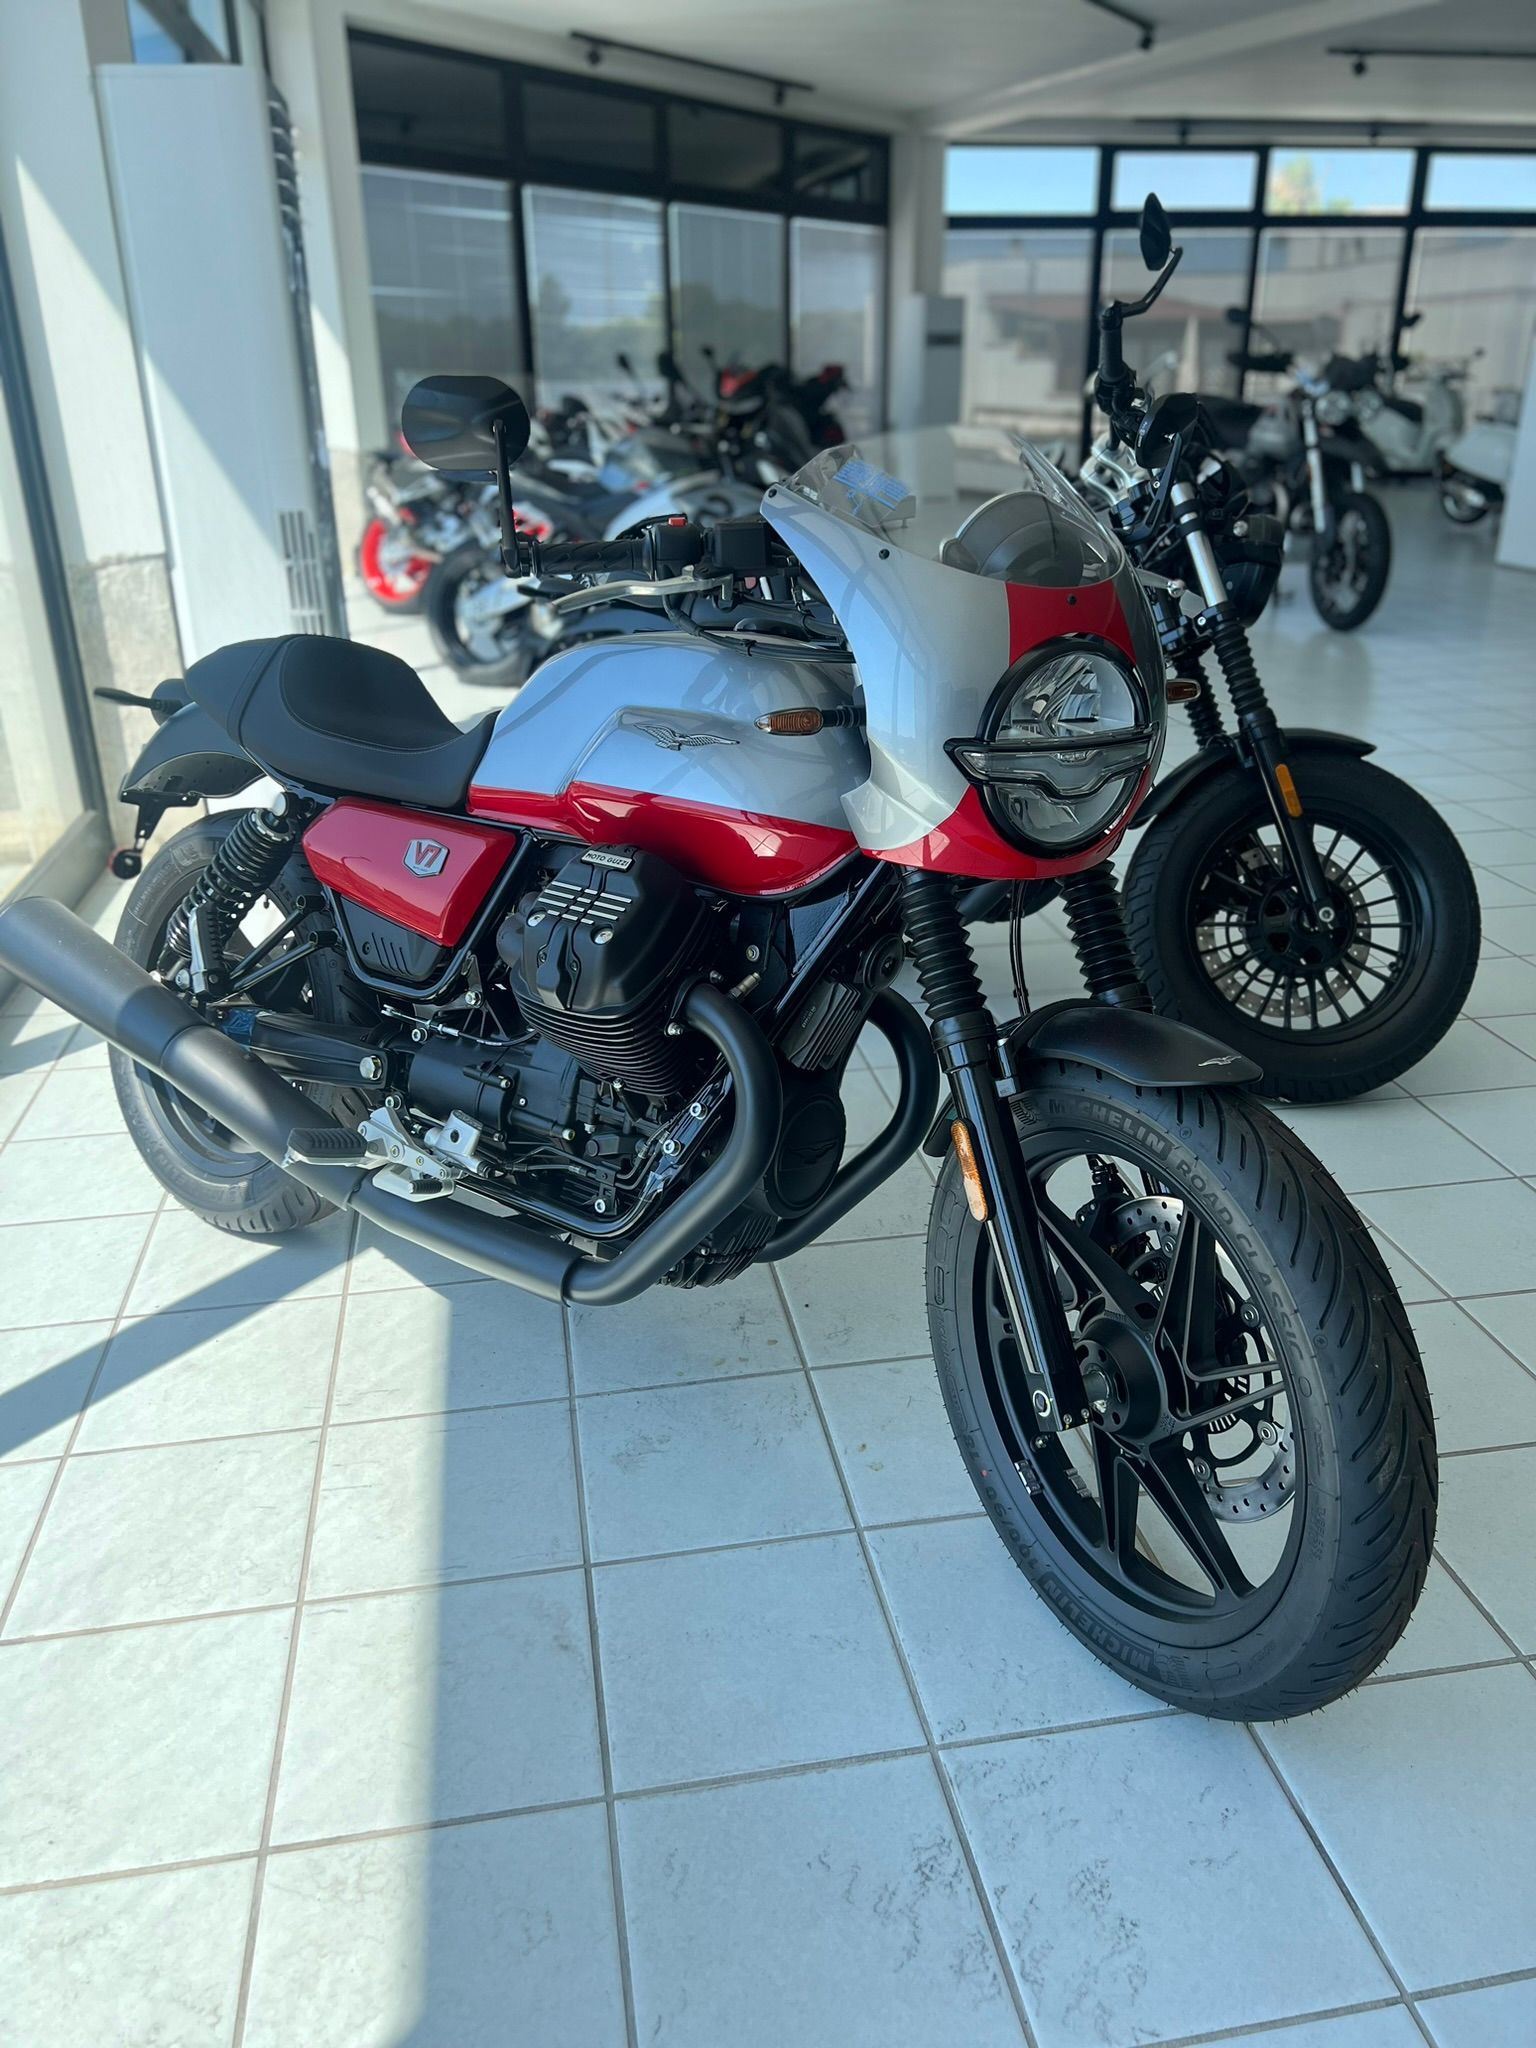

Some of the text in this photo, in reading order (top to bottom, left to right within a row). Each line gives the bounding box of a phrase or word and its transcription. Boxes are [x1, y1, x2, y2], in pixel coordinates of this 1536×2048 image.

[414, 840, 442, 868] V7
[586, 853, 629, 867] MOTO GUZZI
[1051, 1101, 1167, 1154] MICHELIN
[1176, 1160, 1233, 1225] ROAD
[1043, 1578, 1151, 1673] MICHELIN
